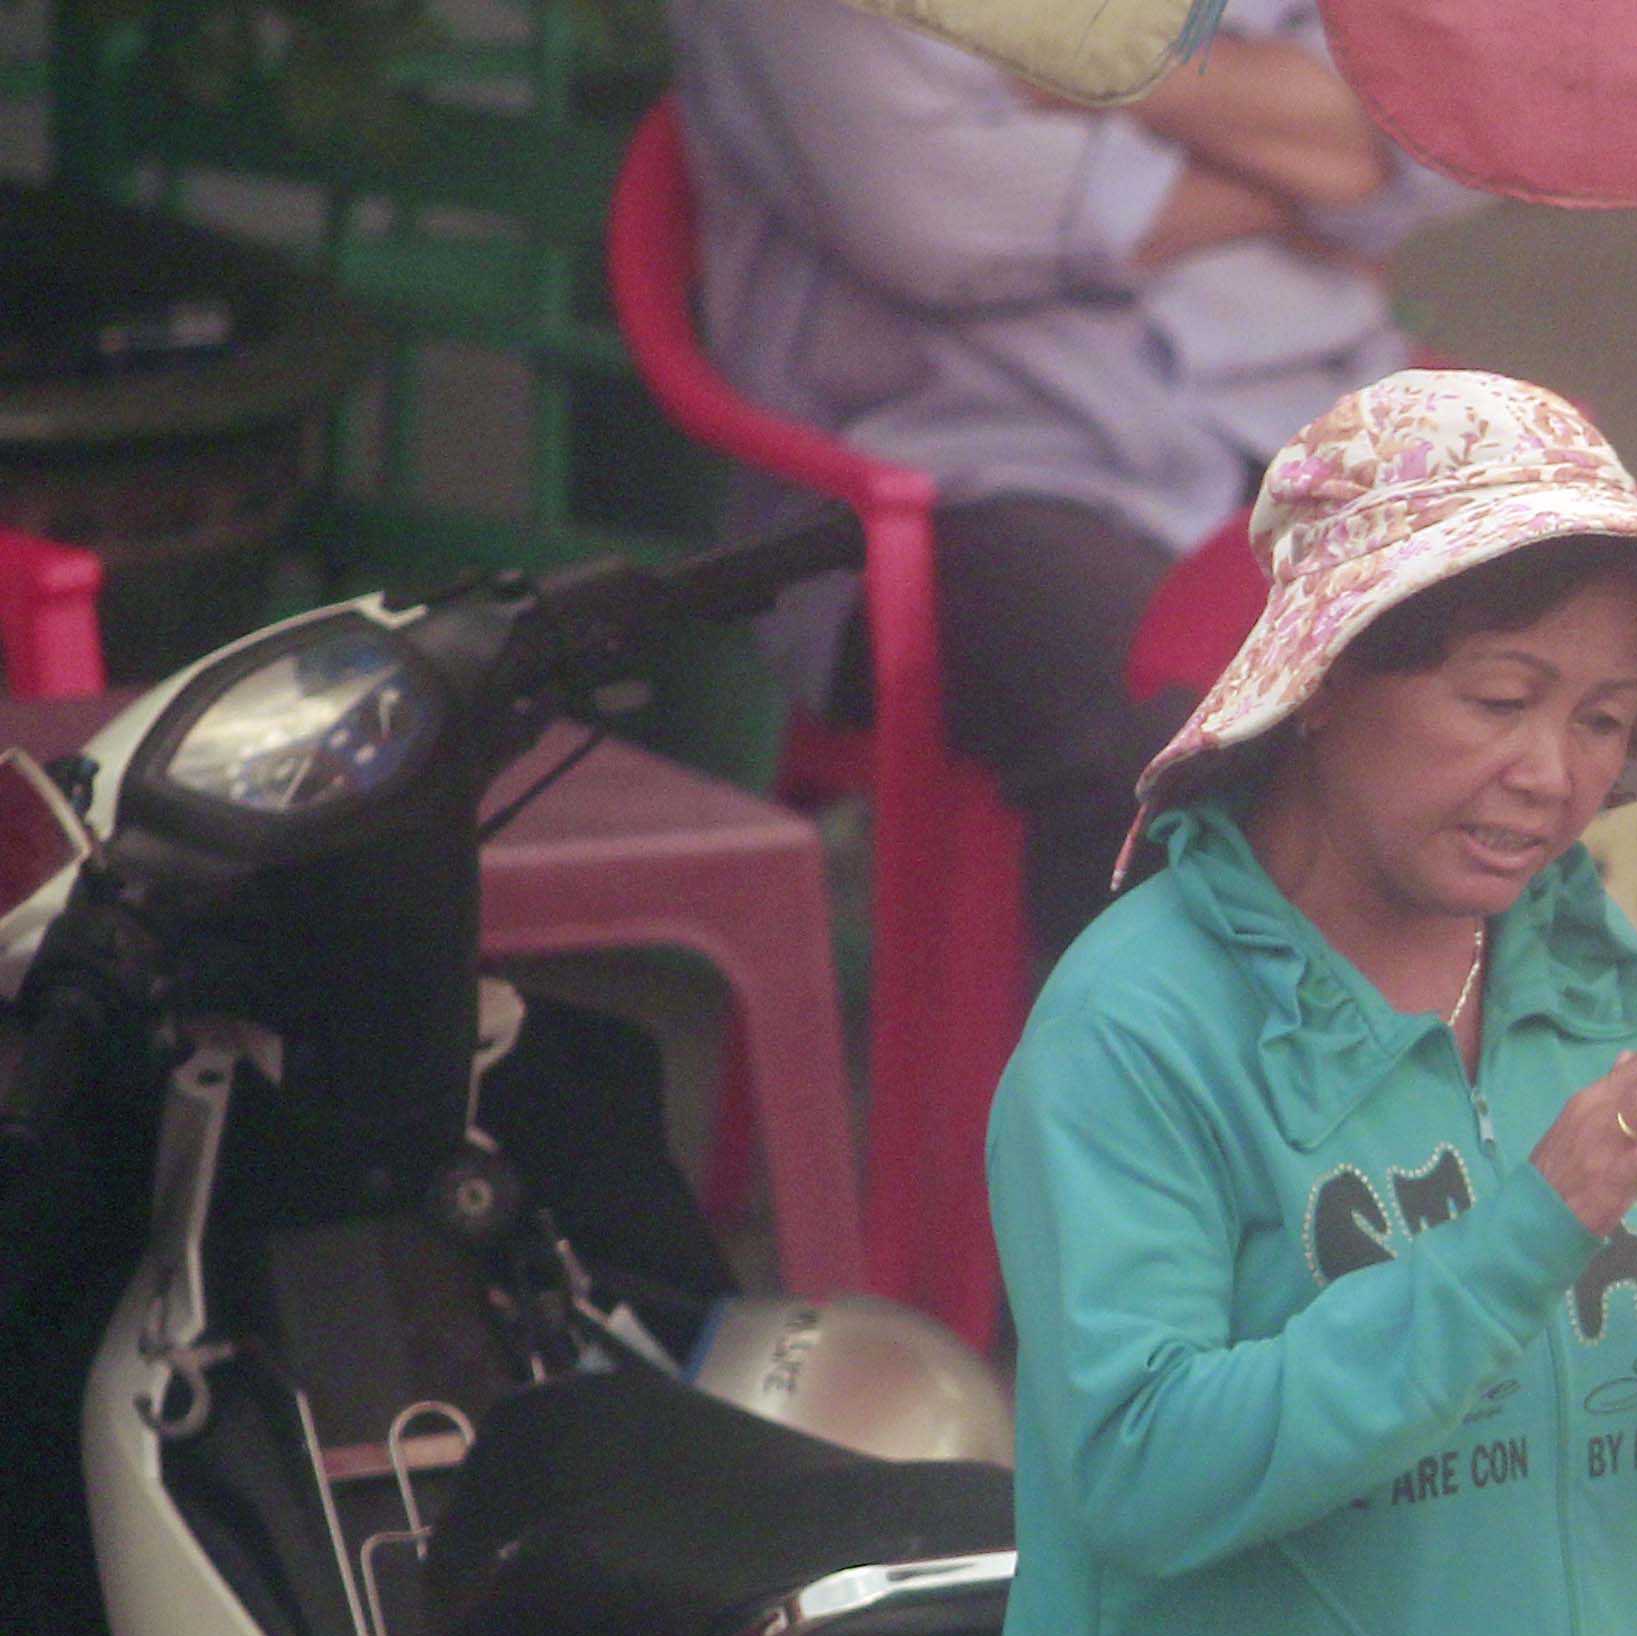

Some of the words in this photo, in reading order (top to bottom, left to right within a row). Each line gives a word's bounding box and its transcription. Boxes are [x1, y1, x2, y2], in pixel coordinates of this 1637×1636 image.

[1391, 1451, 1459, 1506] ARE
[1471, 1437, 1529, 1489] CON
[1586, 1430, 1624, 1481] BY
